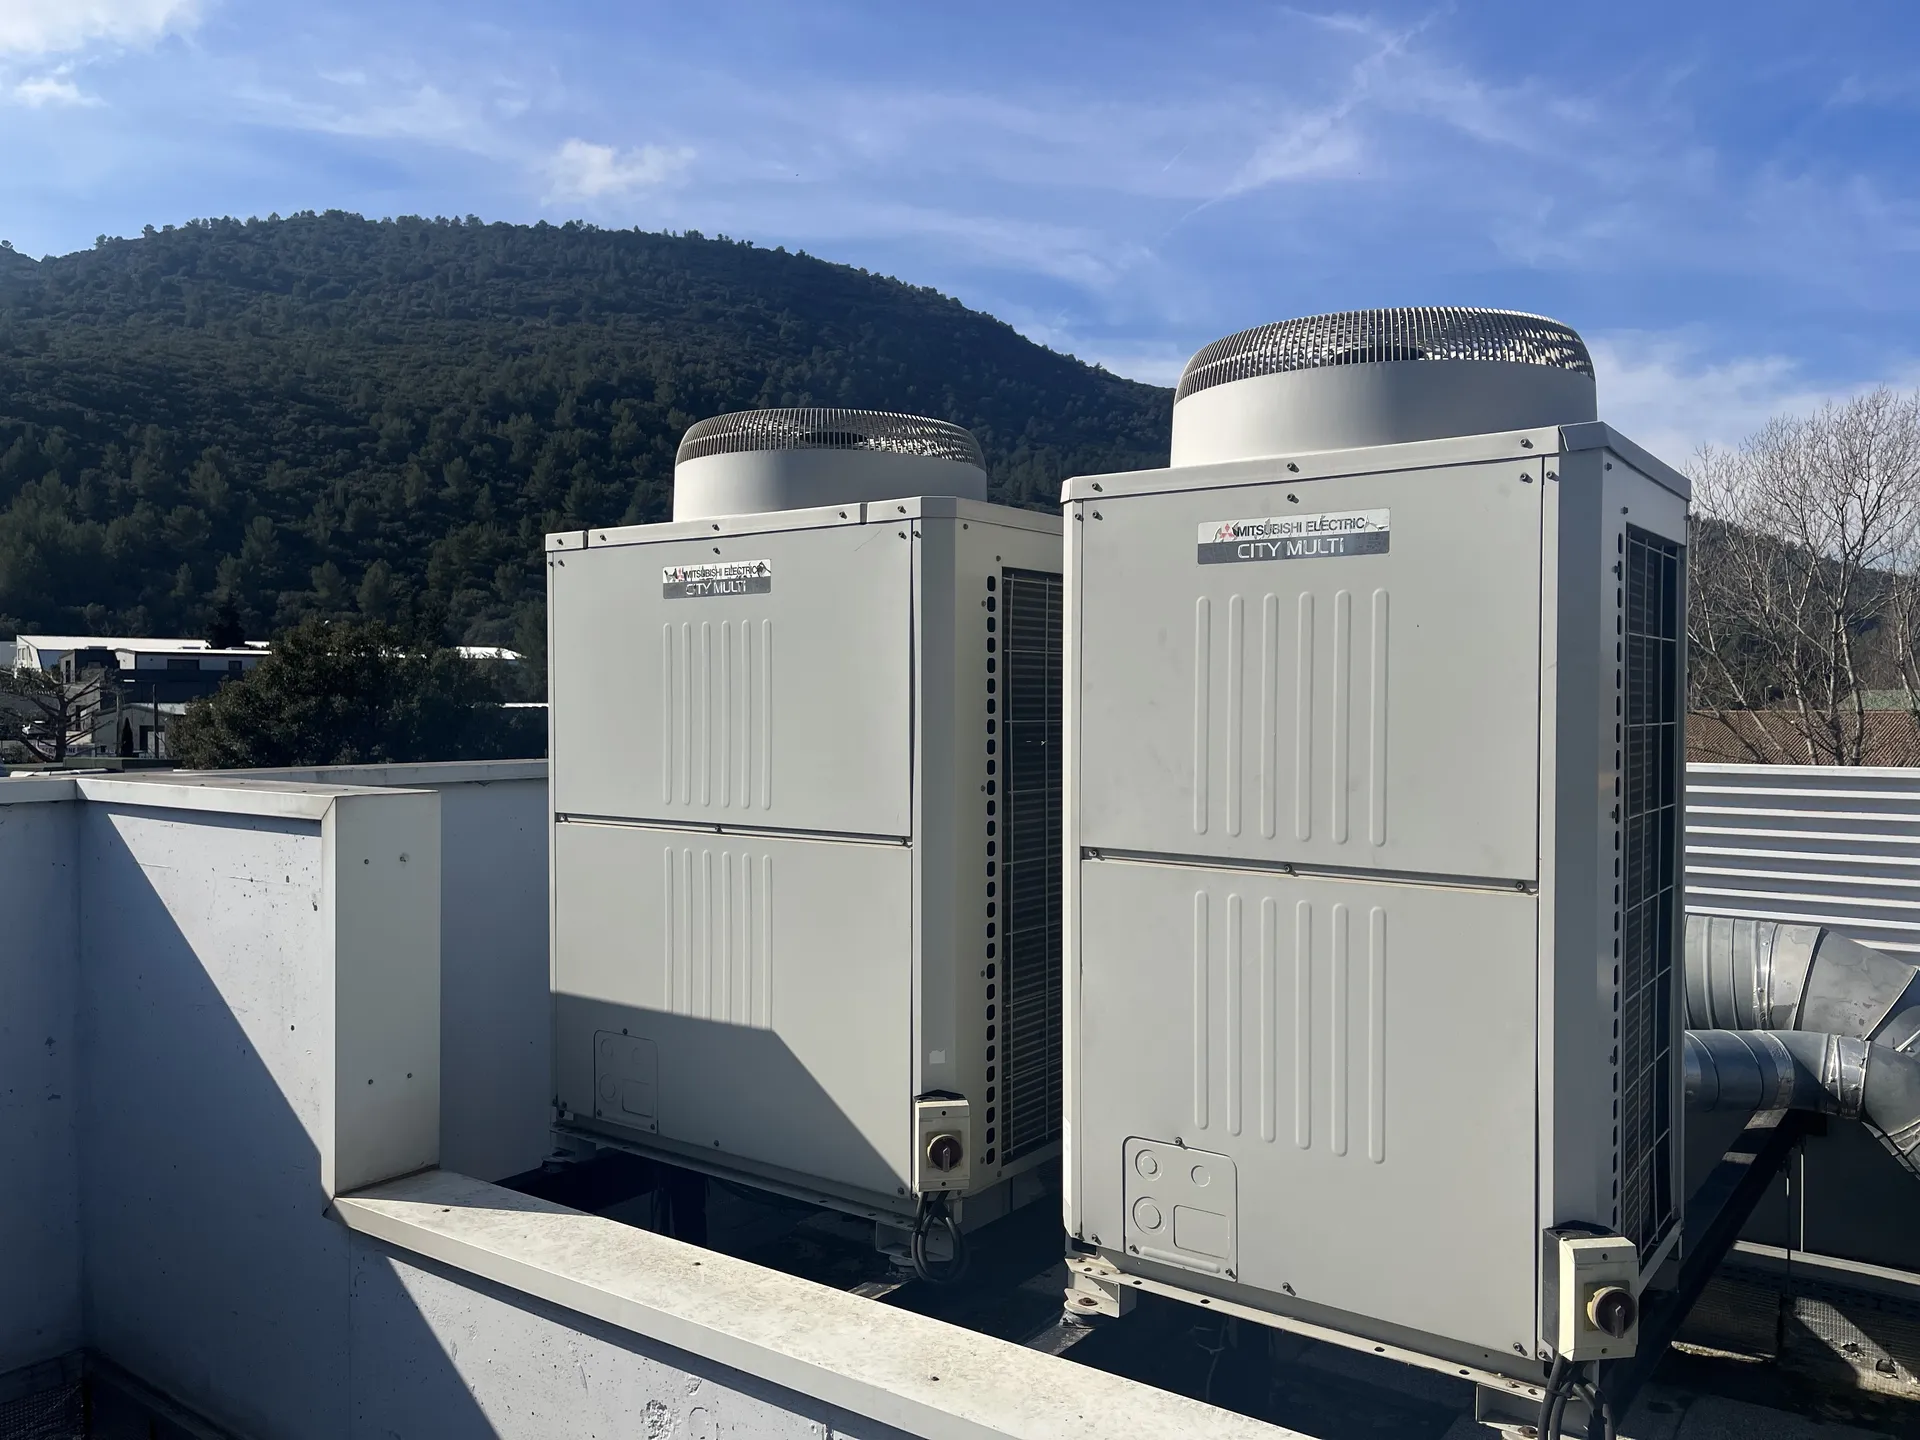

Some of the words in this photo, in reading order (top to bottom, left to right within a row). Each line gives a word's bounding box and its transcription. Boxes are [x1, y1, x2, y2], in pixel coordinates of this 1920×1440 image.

[1237, 520, 1302, 537] MITSUBISHI
[1307, 516, 1366, 533] ELECTRIC
[1238, 540, 1282, 559] CITY
[1287, 538, 1344, 556] MULTI
[713, 580, 746, 594] MULTI
